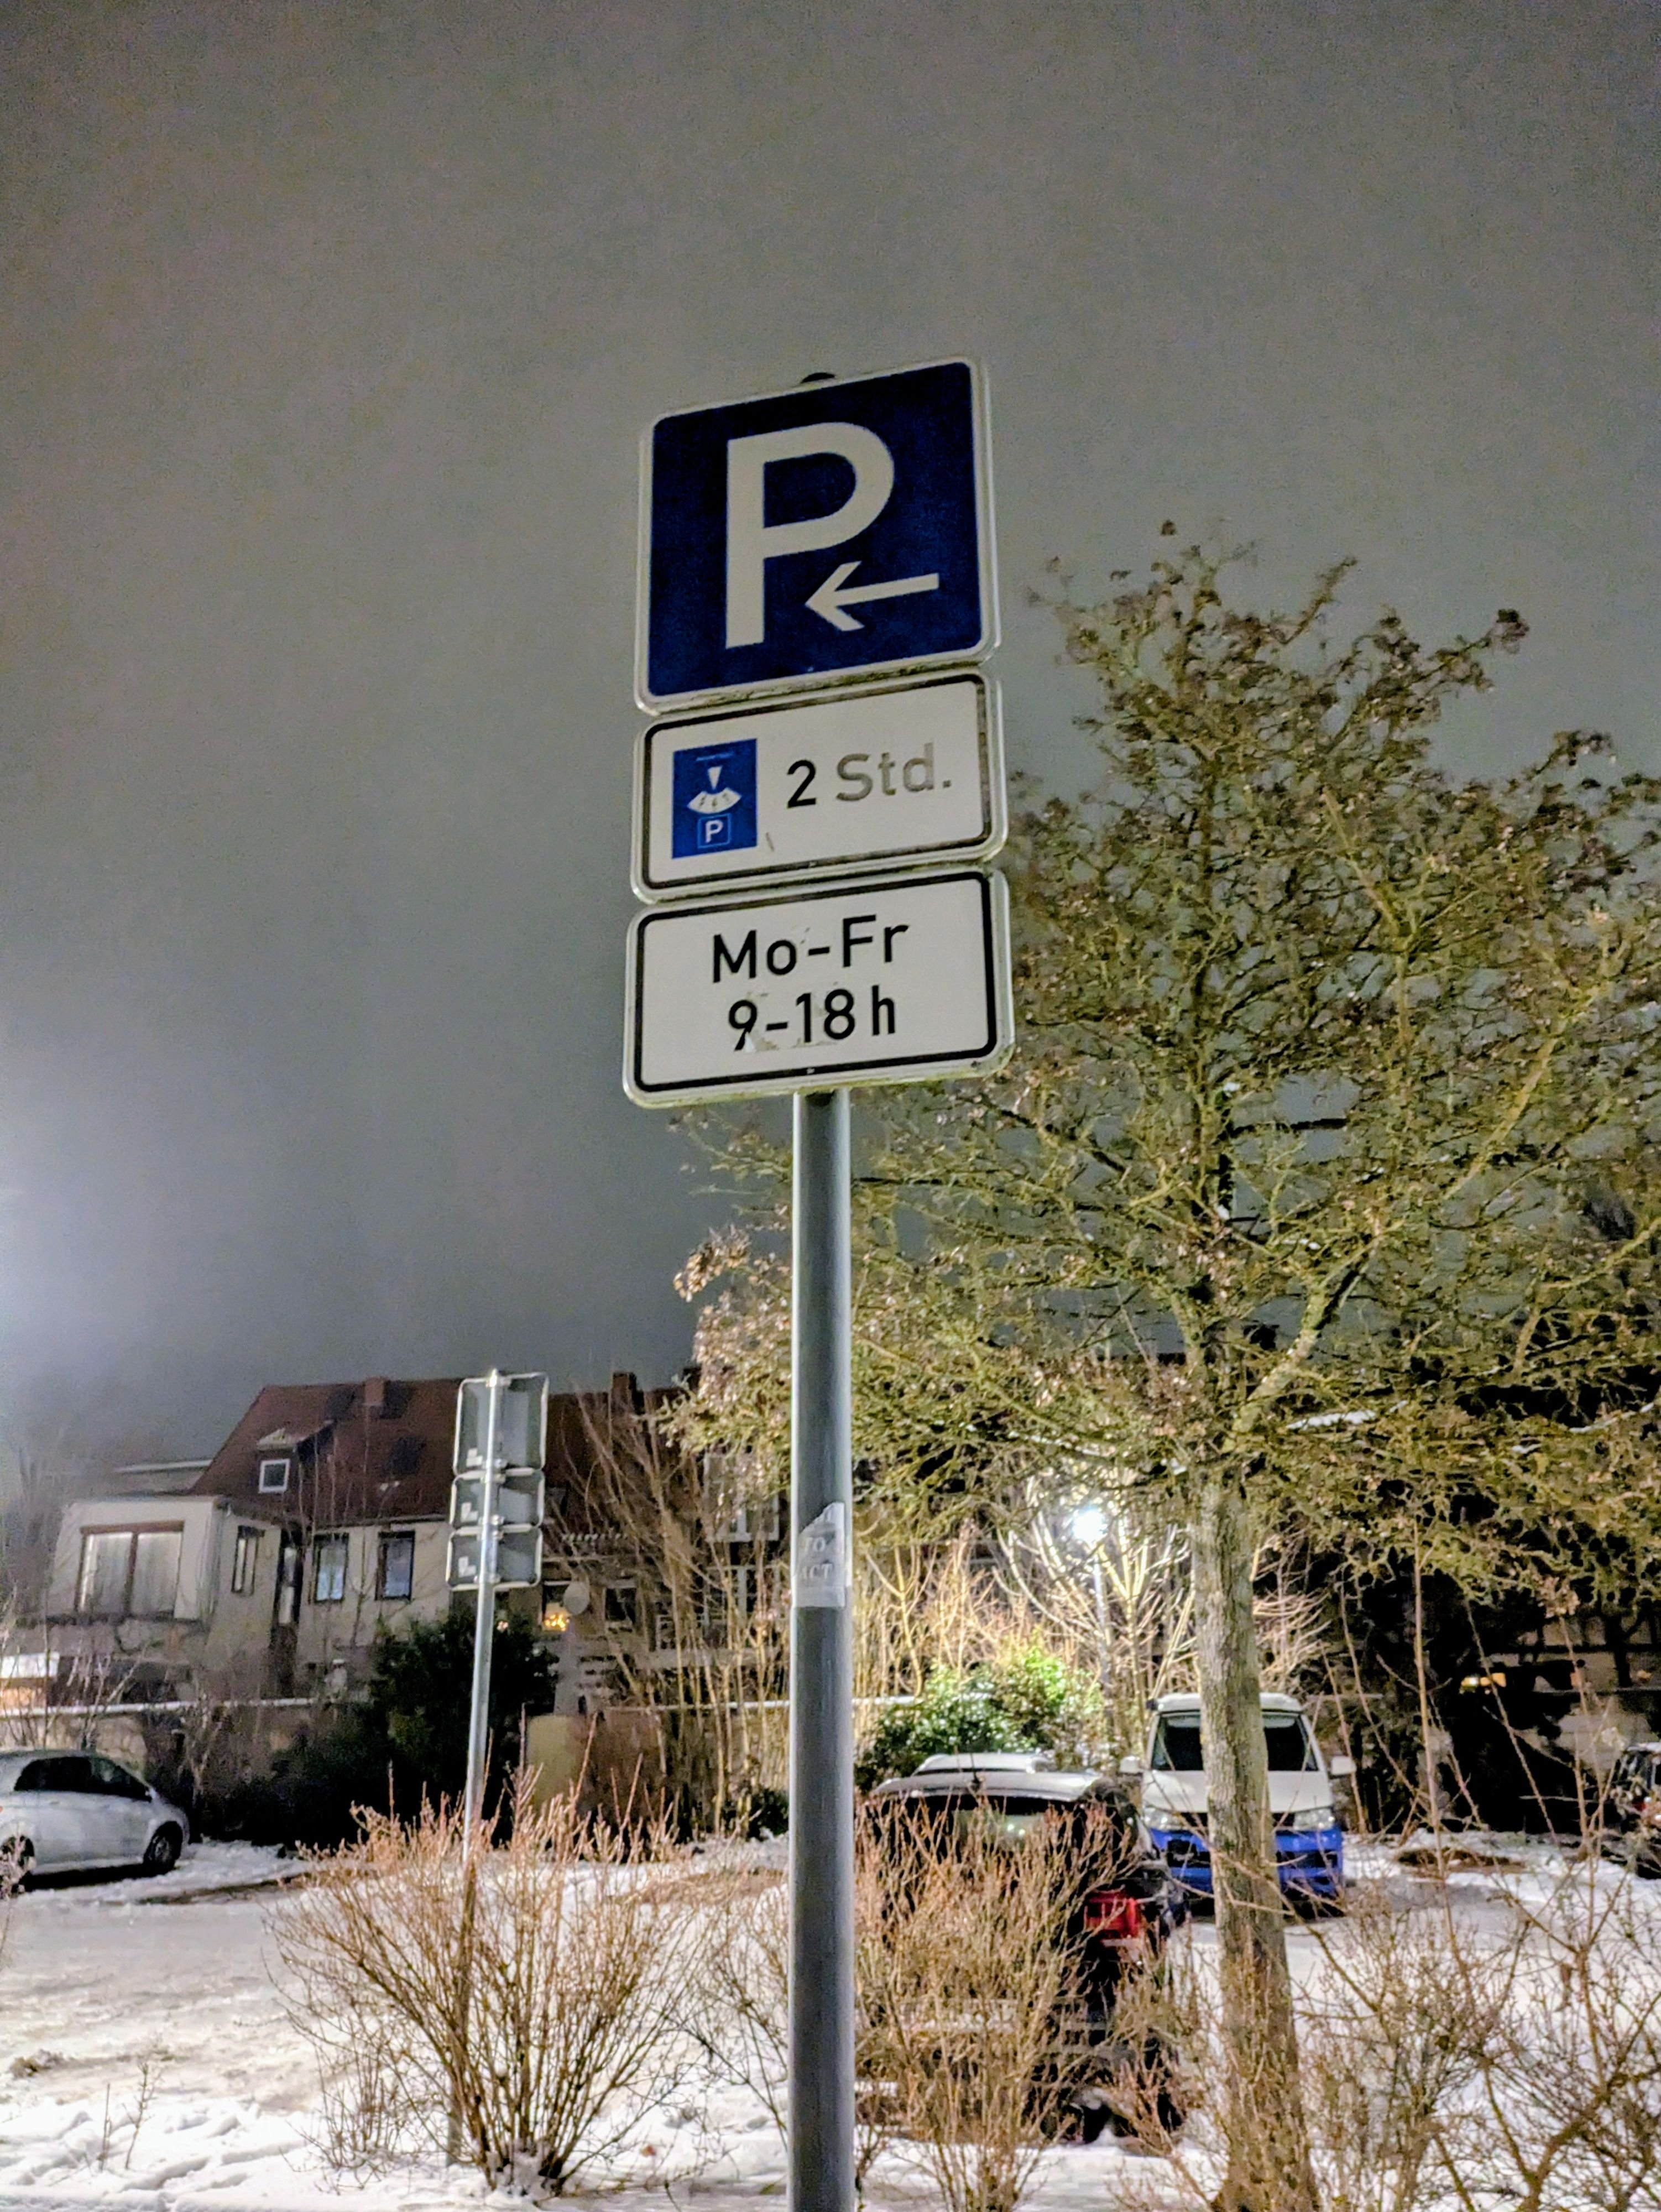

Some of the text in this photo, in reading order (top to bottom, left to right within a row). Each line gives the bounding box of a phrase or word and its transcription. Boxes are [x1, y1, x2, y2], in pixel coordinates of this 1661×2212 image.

[725, 422, 894, 648] P
[787, 743, 952, 808] 2 Std.
[706, 820, 723, 843] P
[713, 914, 909, 983] Mo-Fr
